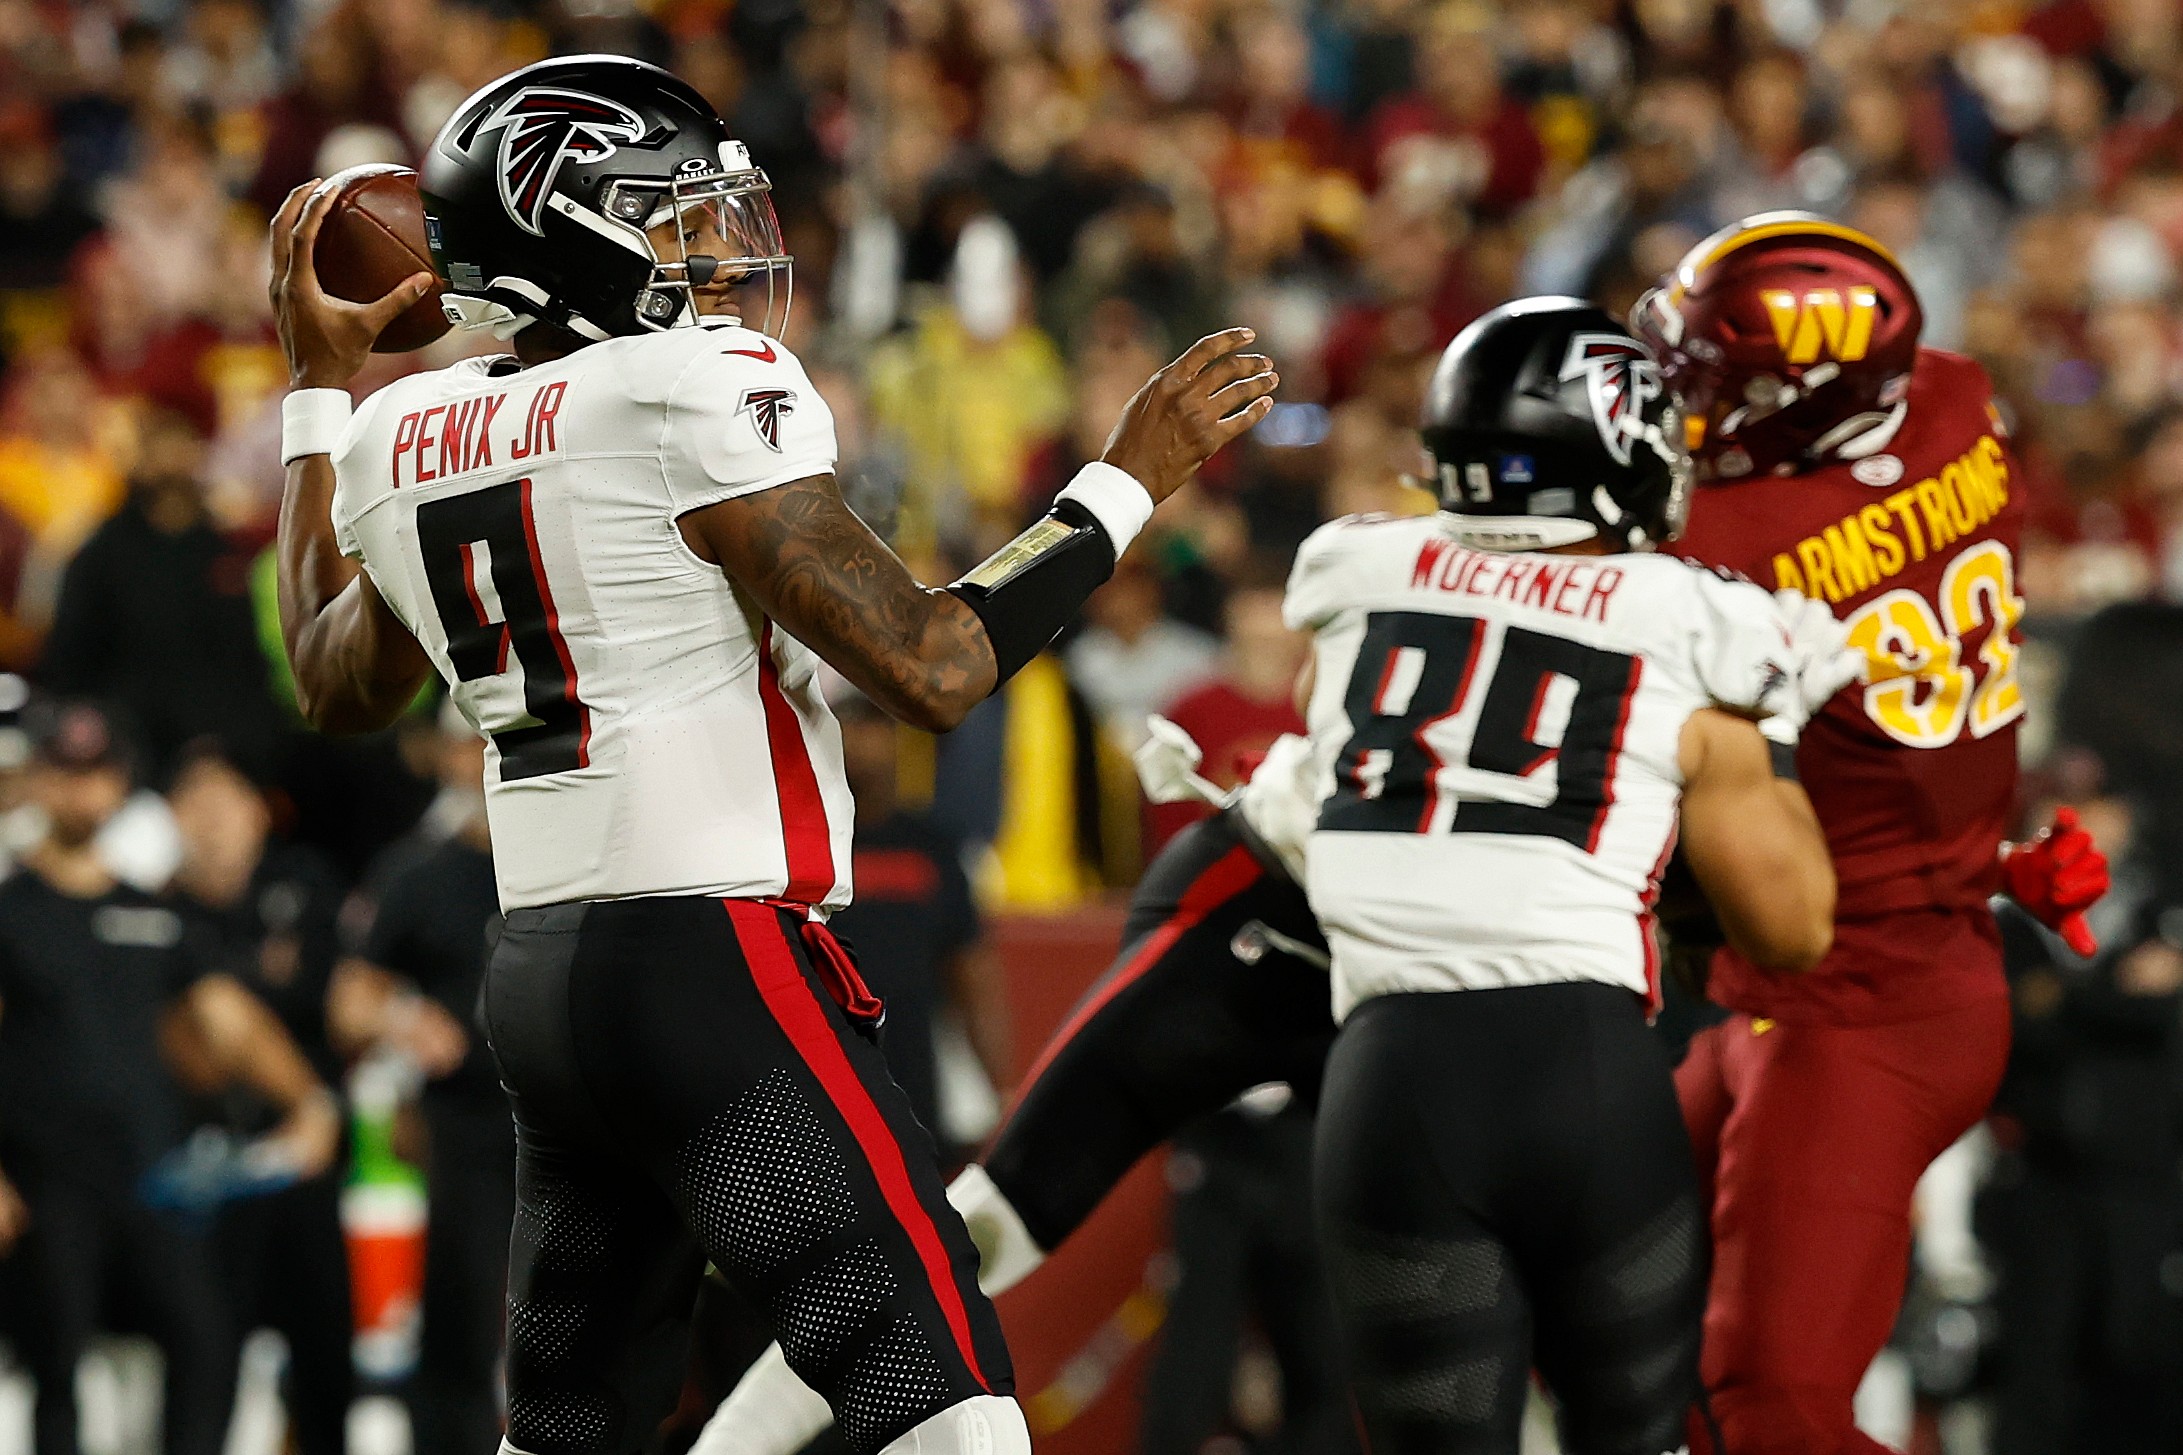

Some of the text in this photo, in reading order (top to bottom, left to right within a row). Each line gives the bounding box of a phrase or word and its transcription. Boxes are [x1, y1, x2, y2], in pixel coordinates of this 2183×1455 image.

[392, 380, 568, 488] PENIX JR
[1772, 434, 2009, 604] ARMSTRONG
[417, 478, 590, 782] 9
[1411, 540, 1624, 622] WOERNER
[1317, 611, 1642, 854] 89
